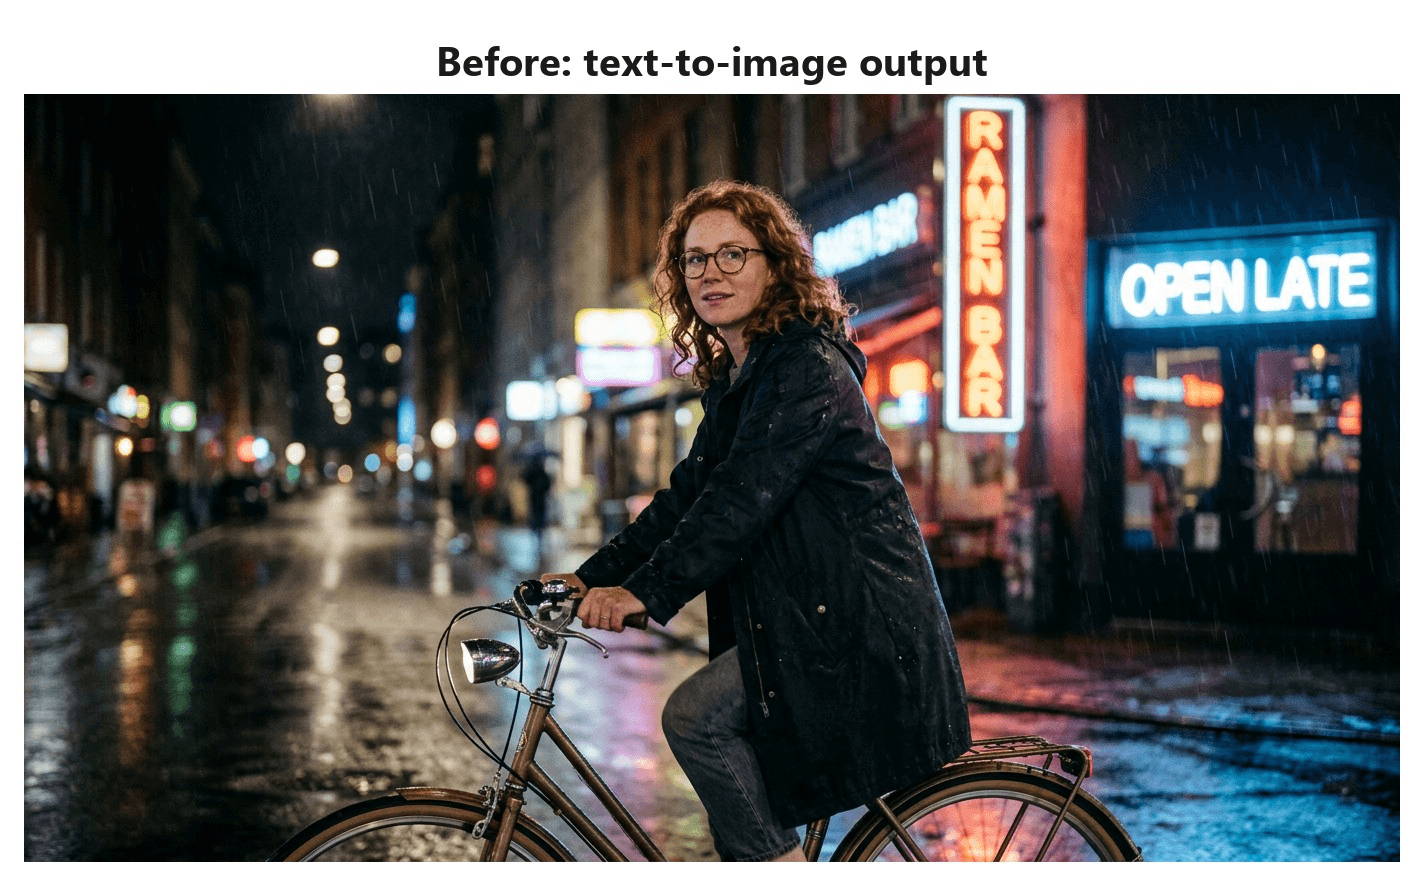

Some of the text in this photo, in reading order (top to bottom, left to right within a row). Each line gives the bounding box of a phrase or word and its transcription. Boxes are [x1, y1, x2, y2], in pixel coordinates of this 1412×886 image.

[964, 109, 1006, 419] RAMEN BAR
[1119, 251, 1372, 318] OPEN LATE
